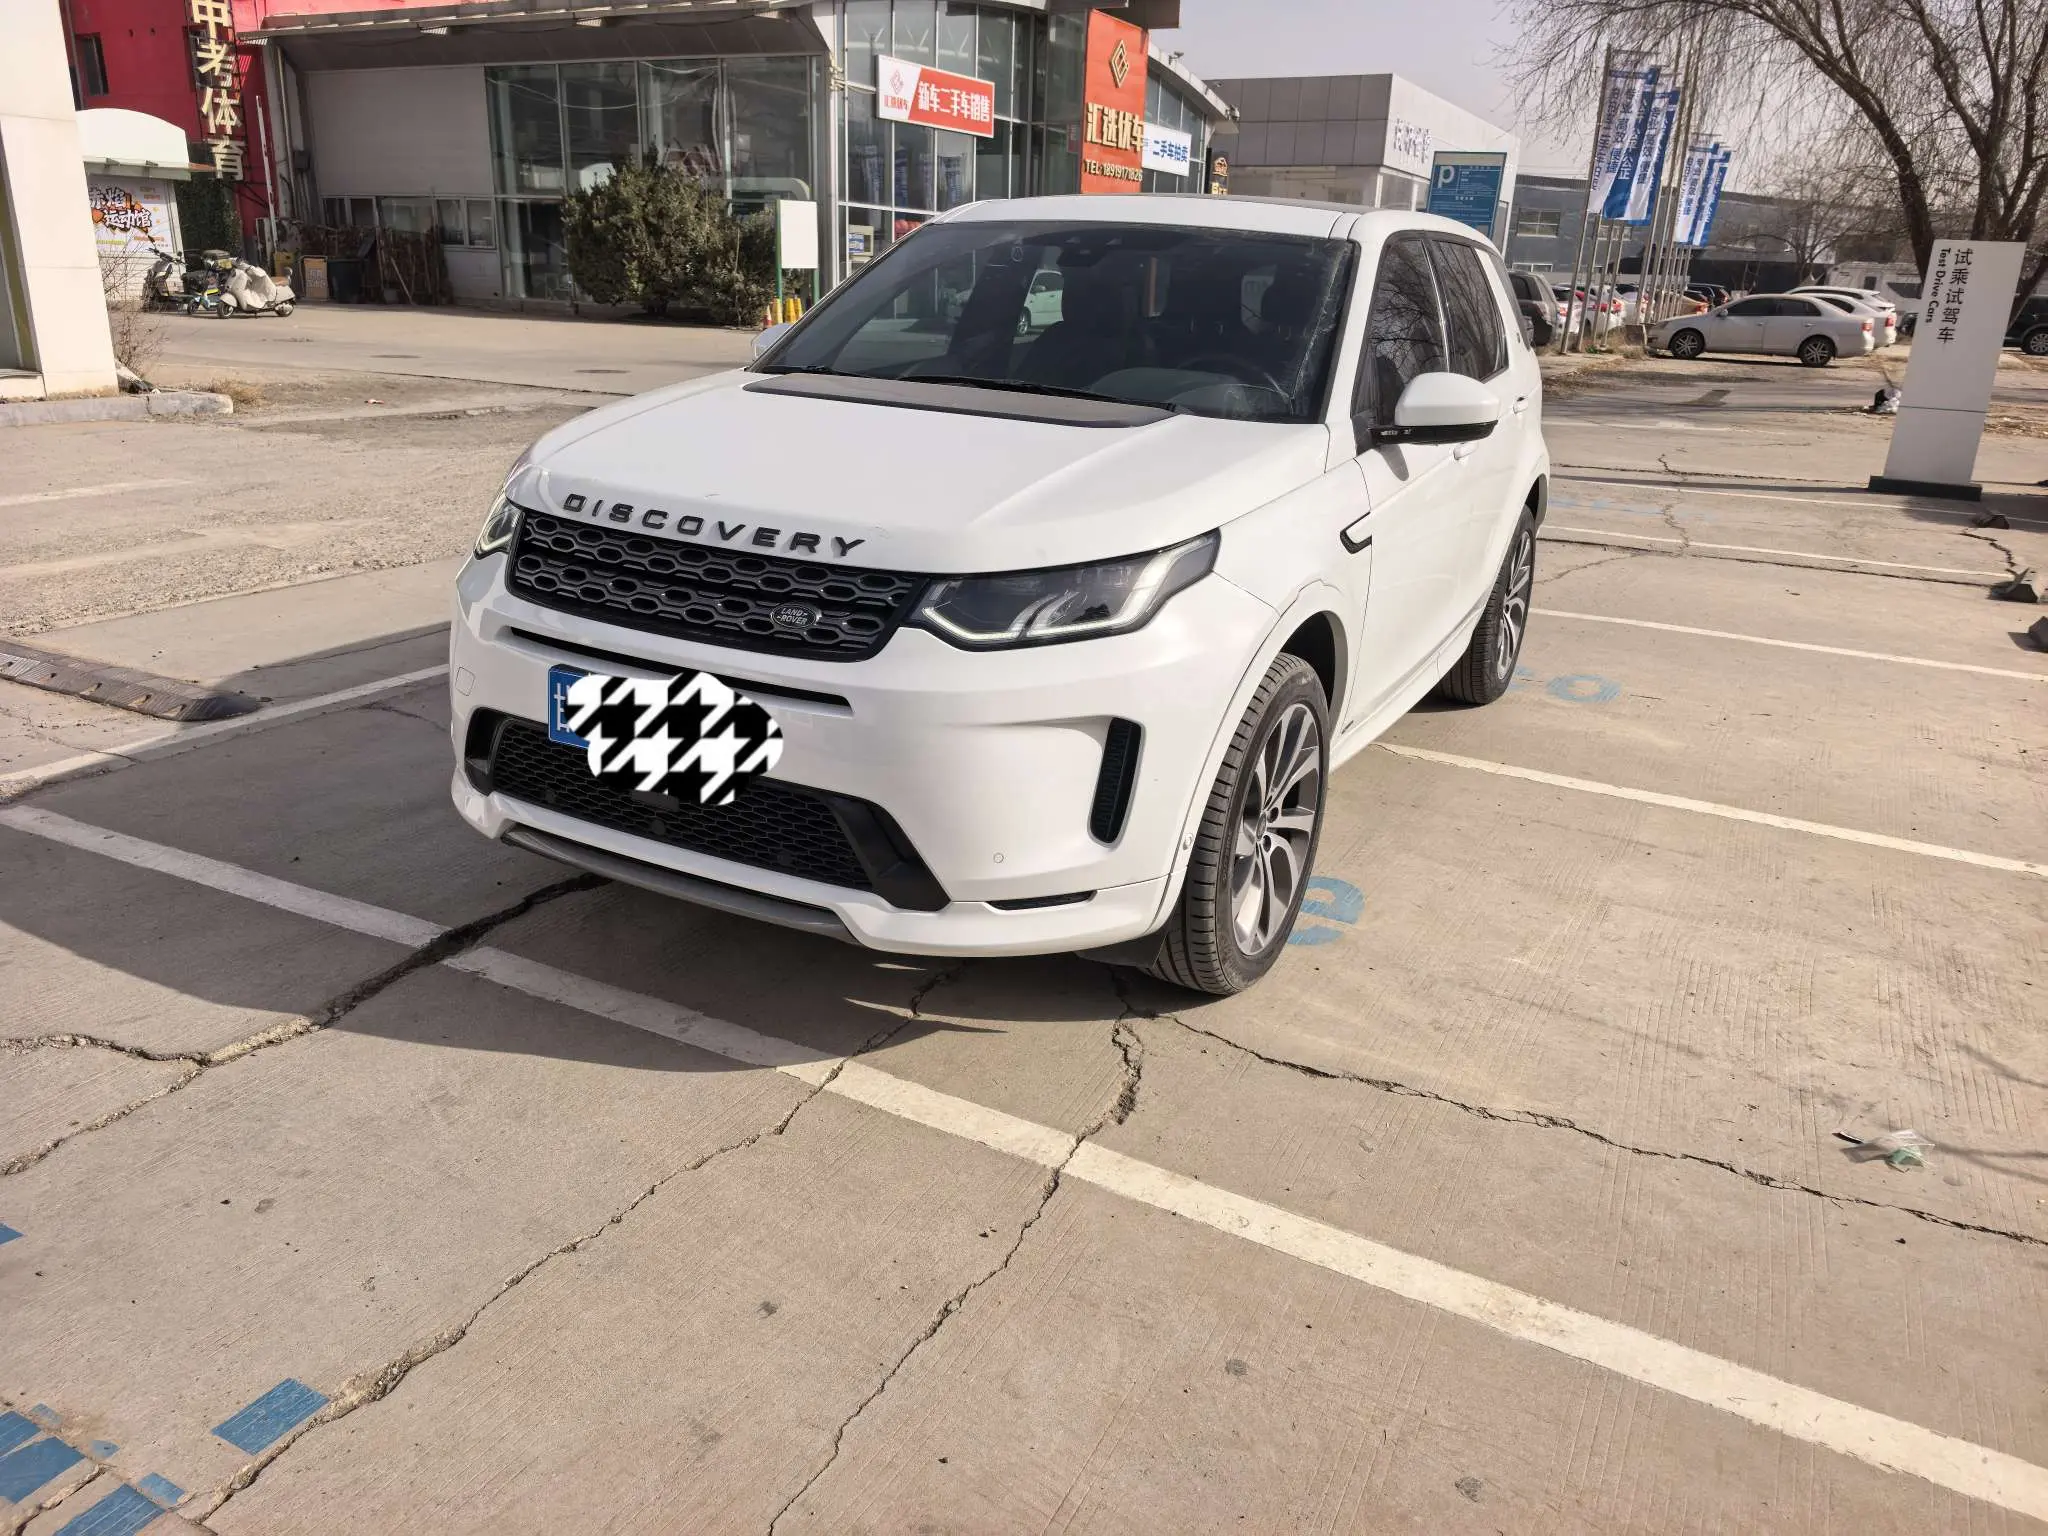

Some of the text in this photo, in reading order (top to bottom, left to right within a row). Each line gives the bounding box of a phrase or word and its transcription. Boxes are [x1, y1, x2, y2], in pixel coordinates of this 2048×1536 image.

[193, 0, 247, 181] 中考体育
[918, 81, 990, 122] 新车二手车销售
[1087, 102, 1145, 152] 汇选优车
[1153, 140, 1188, 162] 二手车拍卖
[104, 208, 152, 230] 运动馆
[1924, 247, 1951, 323] Test Drive Cars
[1936, 247, 1974, 344] 试乘试驾车
[563, 493, 866, 557] DISCOVERY
[781, 607, 803, 617] LAND
[781, 614, 808, 625] ROVER
